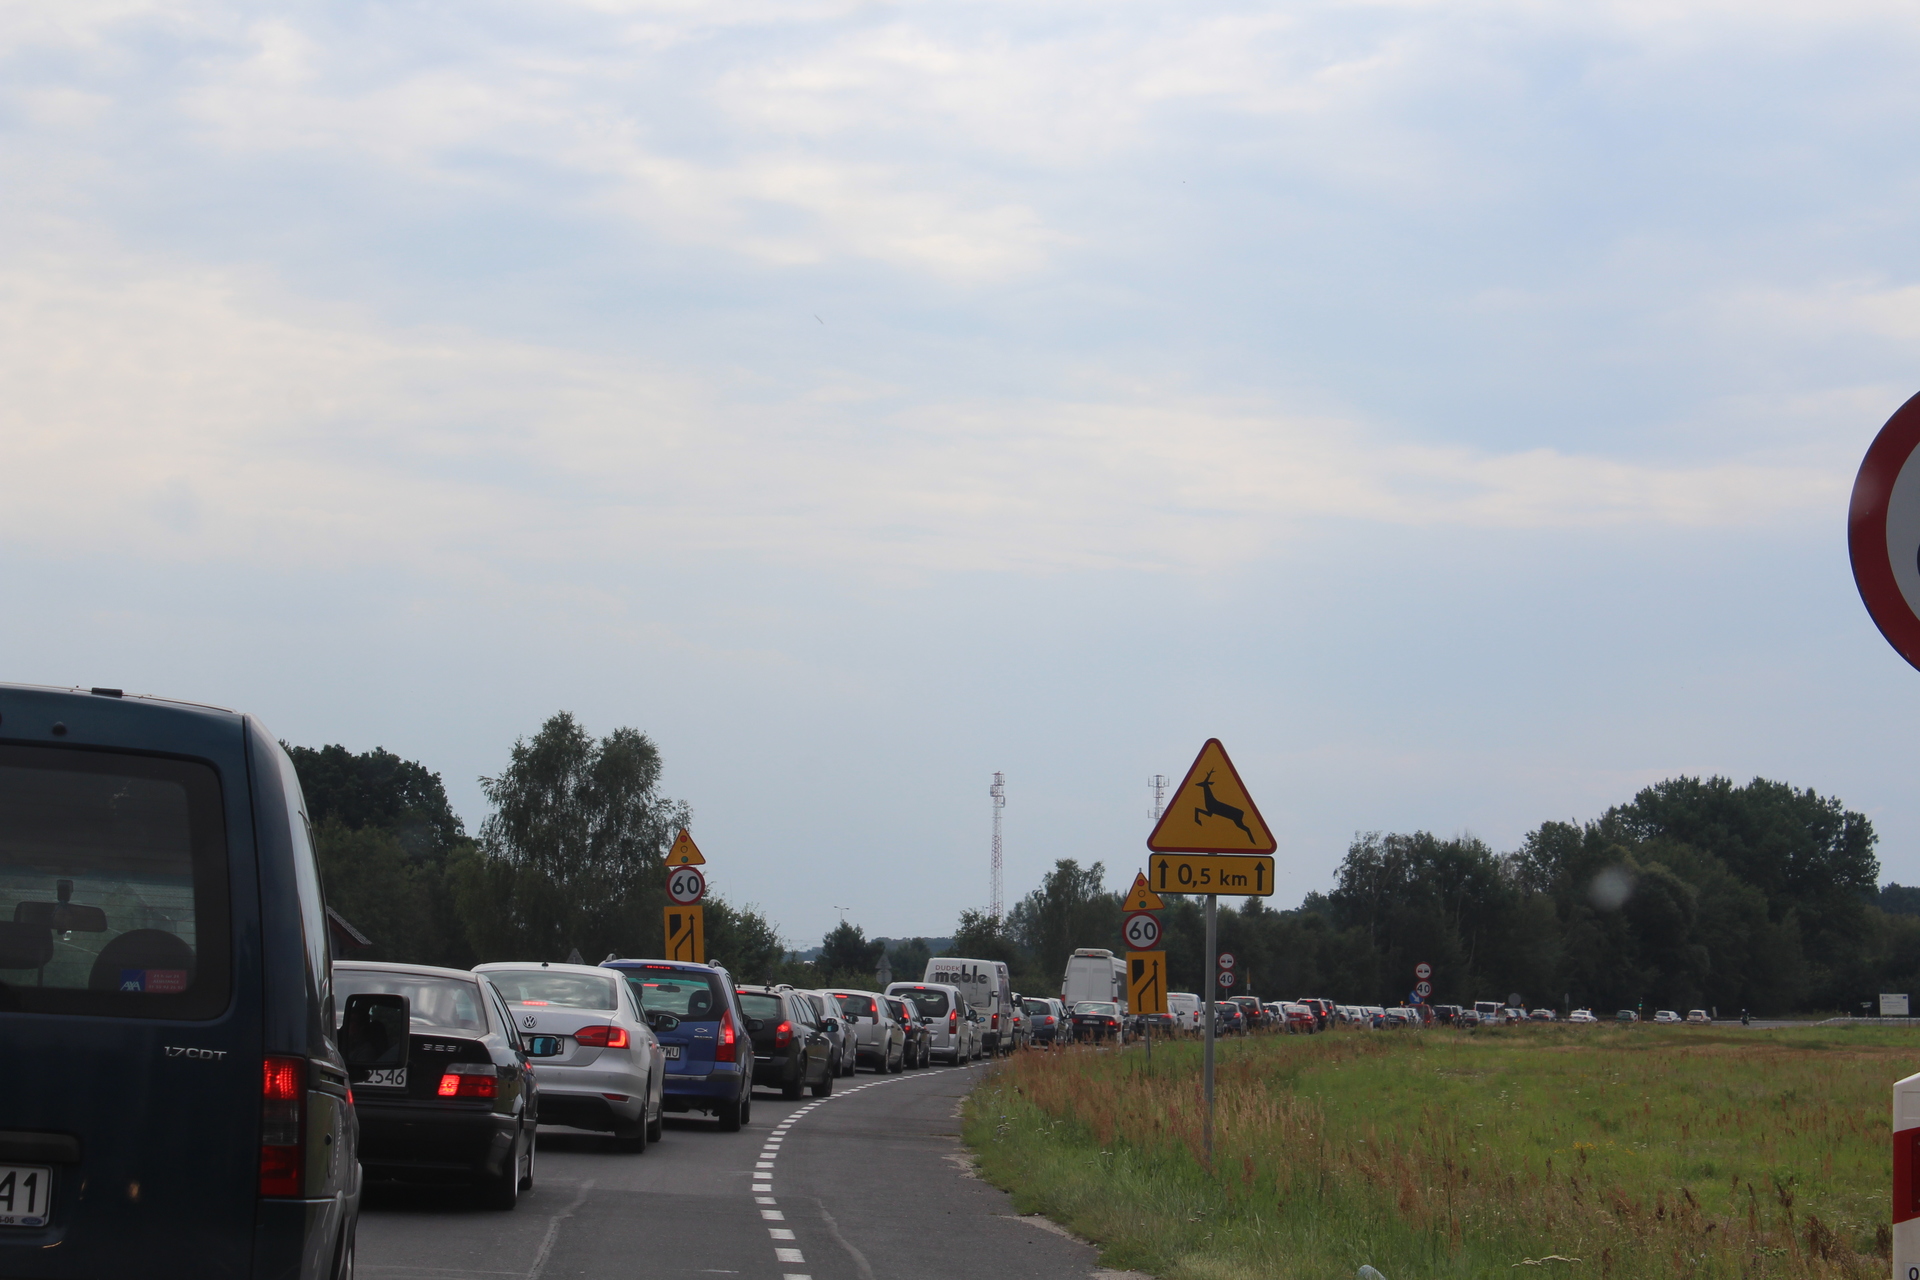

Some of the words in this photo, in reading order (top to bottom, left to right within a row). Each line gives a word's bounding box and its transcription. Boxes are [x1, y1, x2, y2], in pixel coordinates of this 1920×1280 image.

[1177, 863, 1211, 888] 0,5
[1219, 869, 1248, 886] km
[672, 876, 699, 895] 60
[1128, 921, 1157, 940] 60
[935, 964, 960, 972] DUDEK
[935, 964, 988, 984] meble
[119, 981, 141, 991] AXA
[1220, 974, 1233, 984] 40
[1417, 984, 1430, 993] 40
